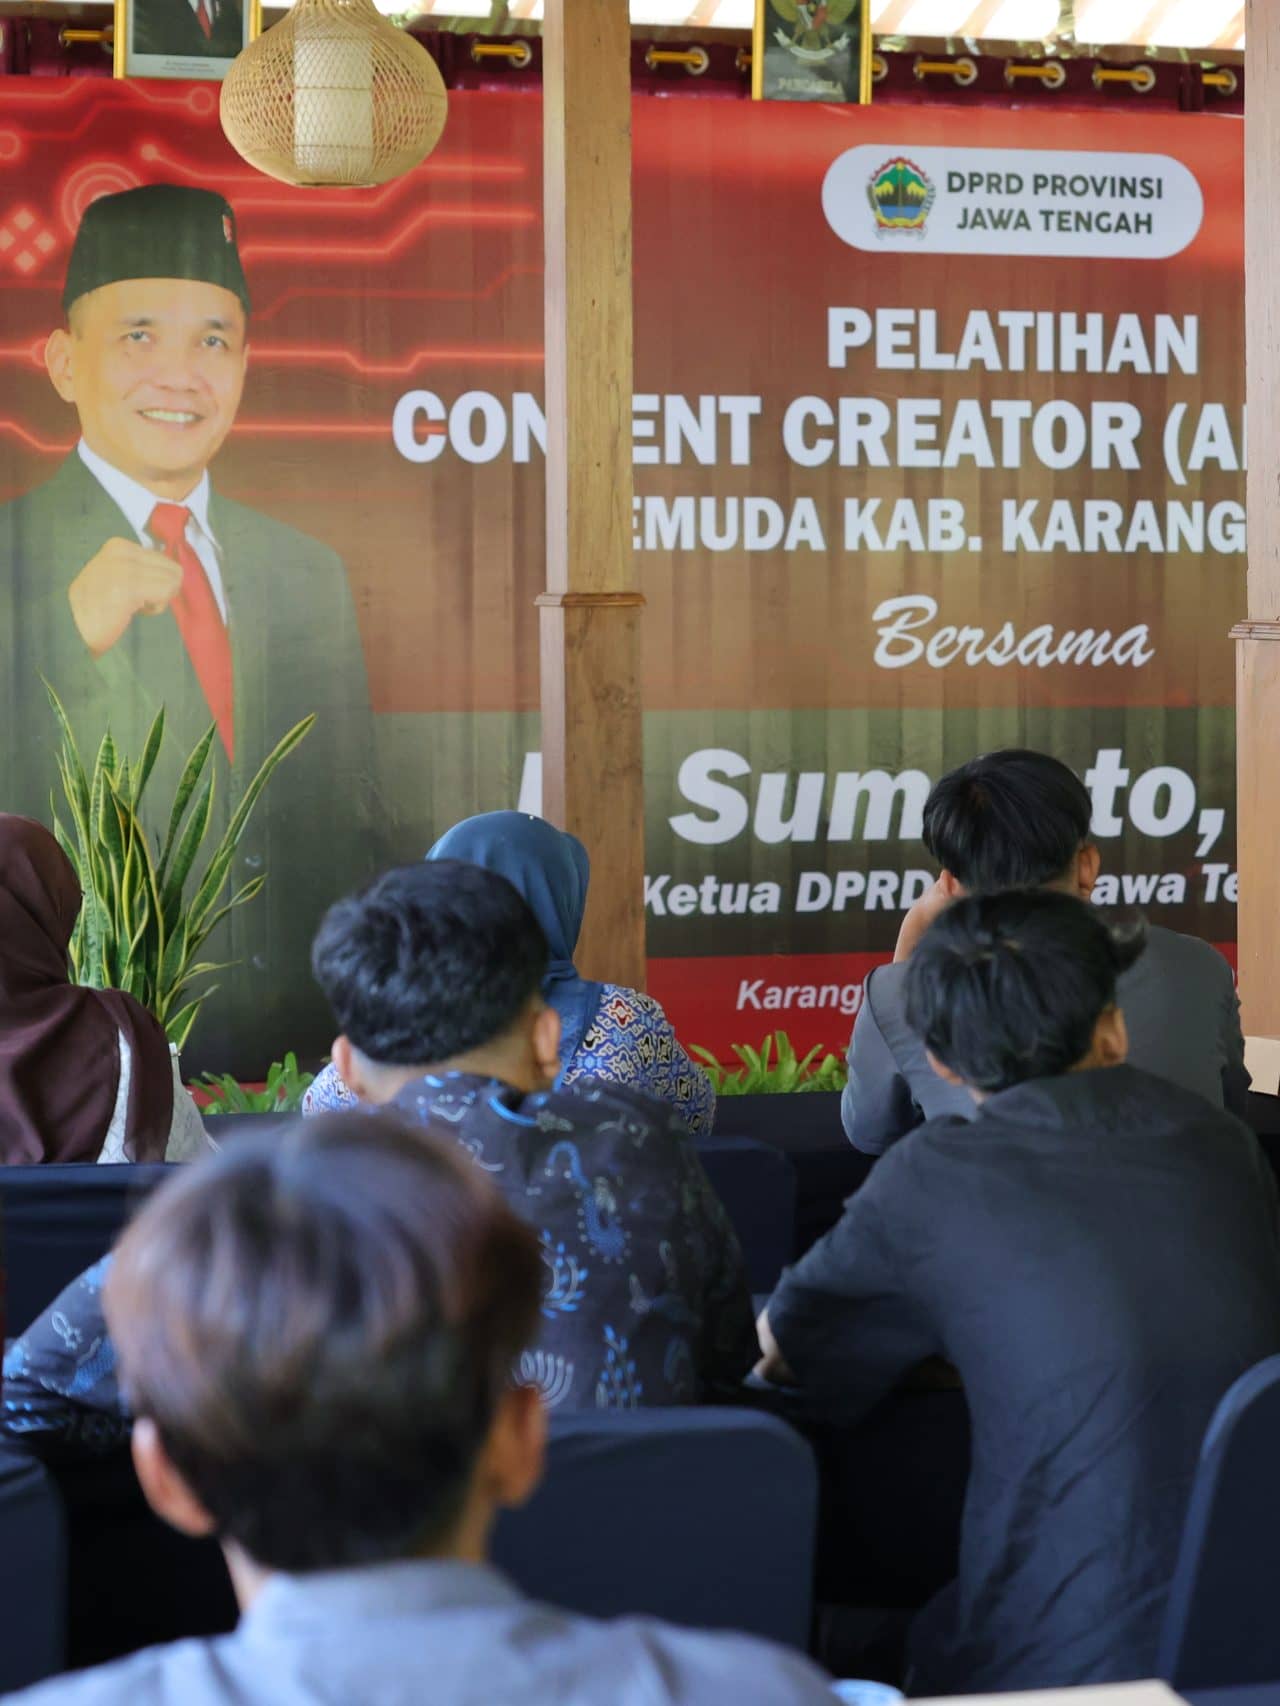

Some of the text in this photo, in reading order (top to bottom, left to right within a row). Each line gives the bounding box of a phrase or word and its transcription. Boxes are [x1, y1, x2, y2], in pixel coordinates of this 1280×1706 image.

[947, 171, 1163, 199] DPRD PROVINSI
[957, 207, 1153, 235] JAWA TENGAH
[827, 307, 1198, 375] PELATIHAN
[391, 389, 762, 466] CONENT
[782, 395, 1142, 470] CREATOR
[844, 497, 983, 553] KAB.
[871, 594, 1155, 669] Bersama
[668, 748, 1225, 857] Sumto,
[643, 873, 781, 916] Ketua
[1090, 872, 1186, 905] awa
